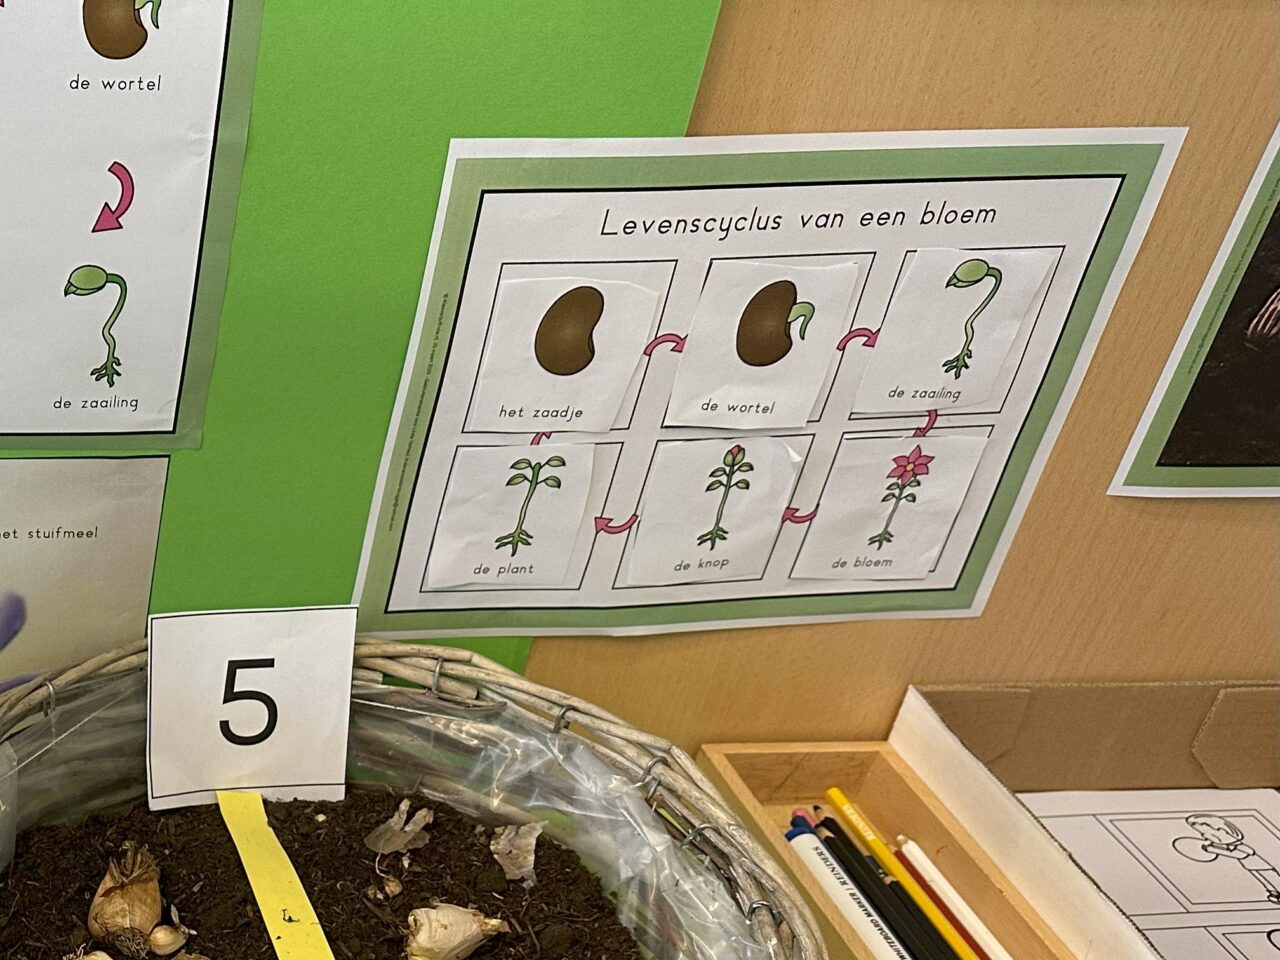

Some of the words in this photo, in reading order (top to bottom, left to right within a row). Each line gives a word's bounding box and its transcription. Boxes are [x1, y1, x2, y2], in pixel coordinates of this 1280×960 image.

[69, 73, 91, 90] de
[101, 74, 162, 91] wortel
[600, 206, 783, 242] Levenscyclus
[800, 213, 844, 229] van
[859, 211, 906, 227] een
[919, 200, 997, 226] bloem
[53, 396, 72, 409] de
[81, 394, 139, 412] zaailing
[888, 385, 905, 398] de
[911, 386, 962, 404] zaailing
[498, 404, 524, 418] het
[532, 405, 584, 423] zaadje
[701, 398, 719, 412] de
[727, 401, 776, 414] wortel
[27, 526, 98, 539] stuifmeel
[473, 563, 491, 575] de
[496, 562, 534, 578] plant
[673, 559, 691, 572] de
[697, 558, 730, 570] knop
[831, 557, 848, 569] de
[853, 556, 893, 568] bloem
[219, 657, 278, 746] 5
[812, 846, 848, 886] REINDERS
[848, 892, 873, 918] MARKER
[870, 918, 907, 960] WHITEBOARD
